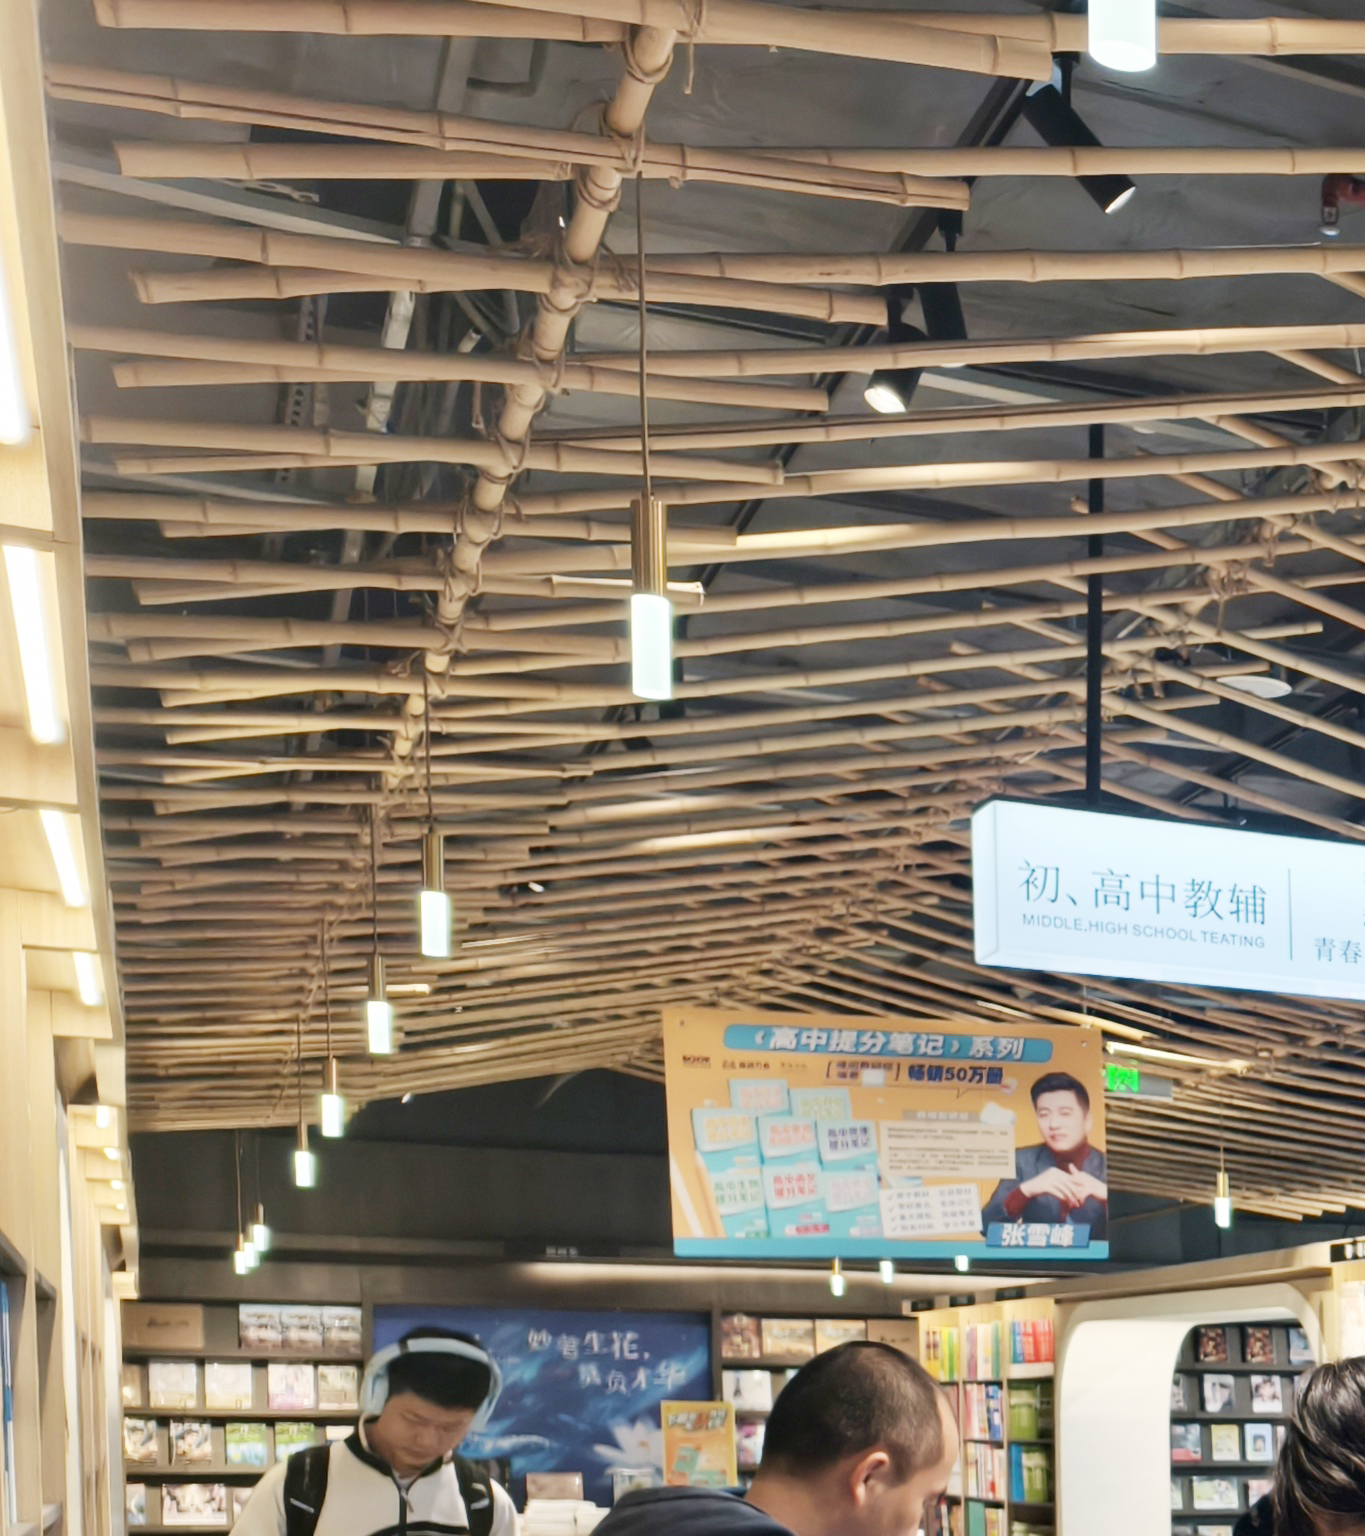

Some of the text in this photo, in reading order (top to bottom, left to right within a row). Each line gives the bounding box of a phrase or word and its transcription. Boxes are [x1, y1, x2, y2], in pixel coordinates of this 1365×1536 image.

[1018, 860, 1267, 926] 初、高中教辅
[1132, 924, 1199, 942] SCHOOL
[1200, 930, 1265, 948] TEATING
[1001, 1223, 1075, 1248] 张雪峰
